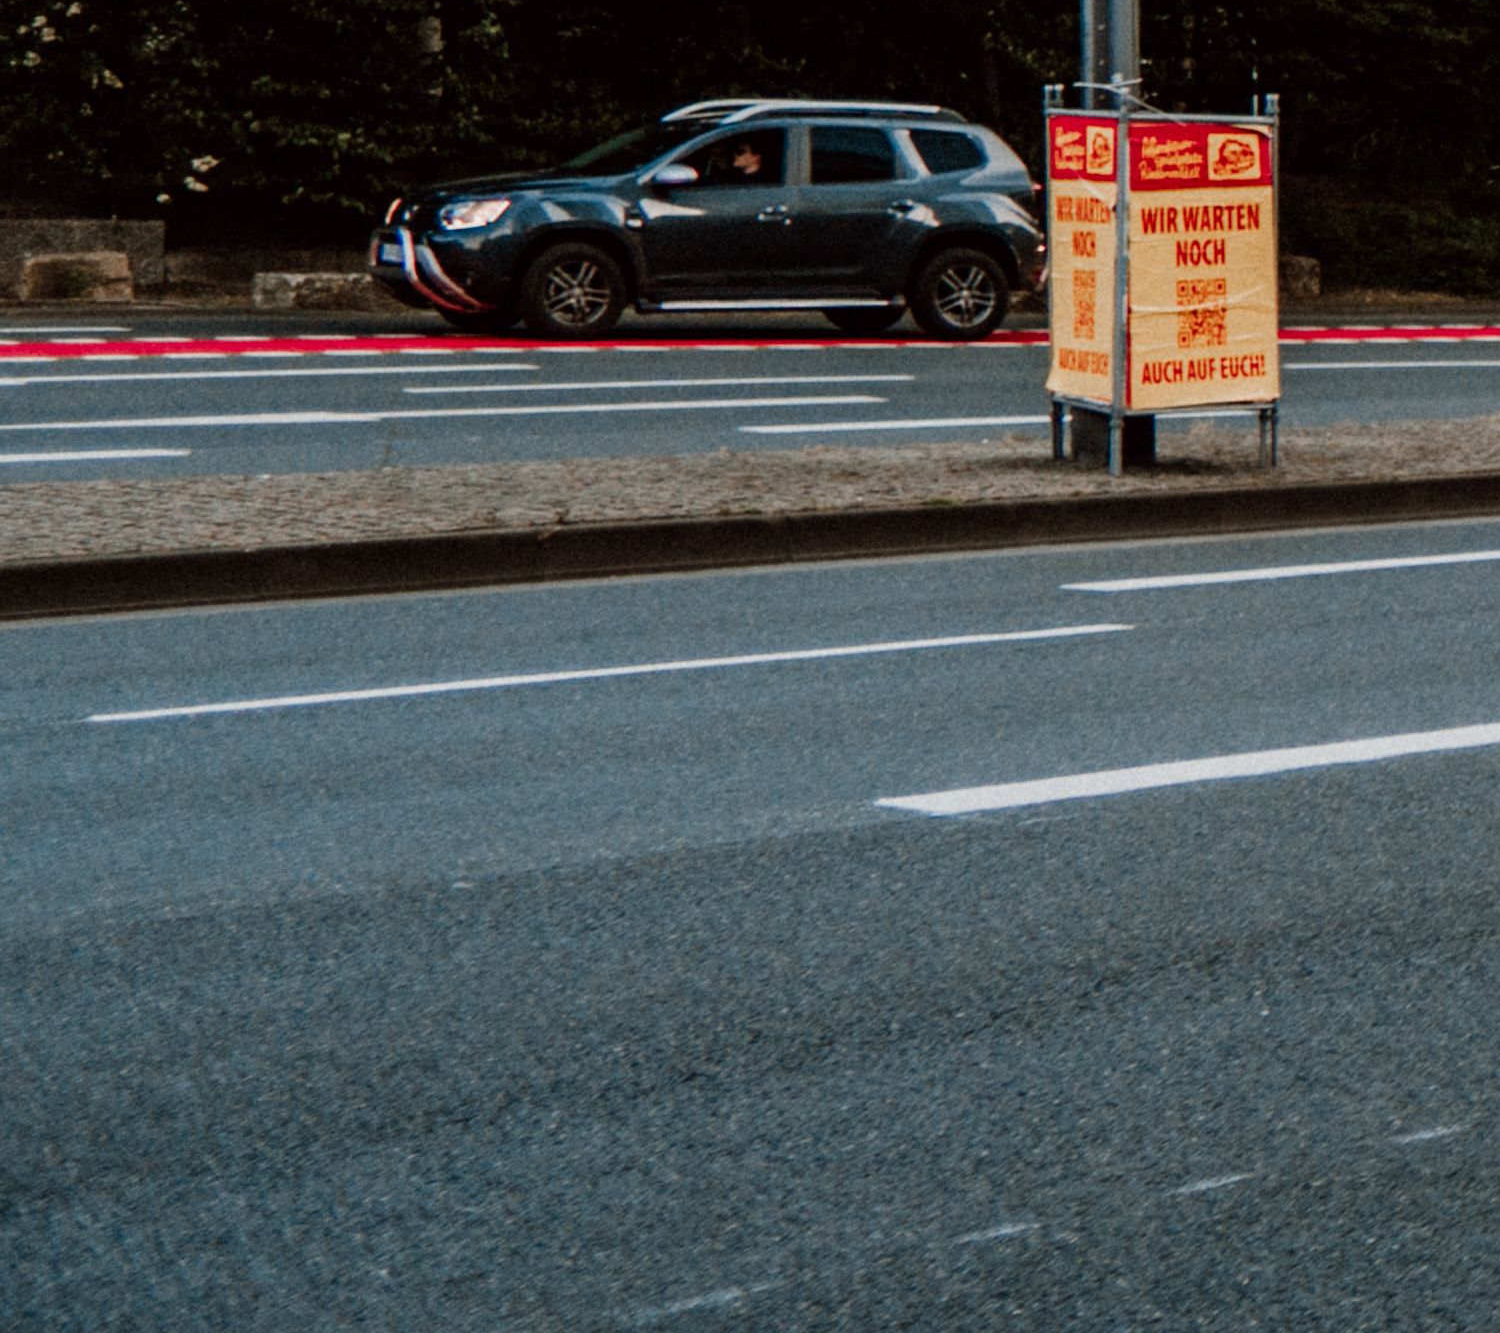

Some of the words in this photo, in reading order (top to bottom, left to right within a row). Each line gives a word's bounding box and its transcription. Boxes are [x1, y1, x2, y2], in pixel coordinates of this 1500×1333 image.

[1141, 207, 1178, 234] WIR
[1183, 203, 1260, 232] WARTEN
[1072, 230, 1096, 258] NOCH
[1176, 238, 1225, 267] NOCH
[1142, 361, 1182, 384] AUCH
[1188, 358, 1216, 381] AUF
[1220, 355, 1266, 378] EUCH!
